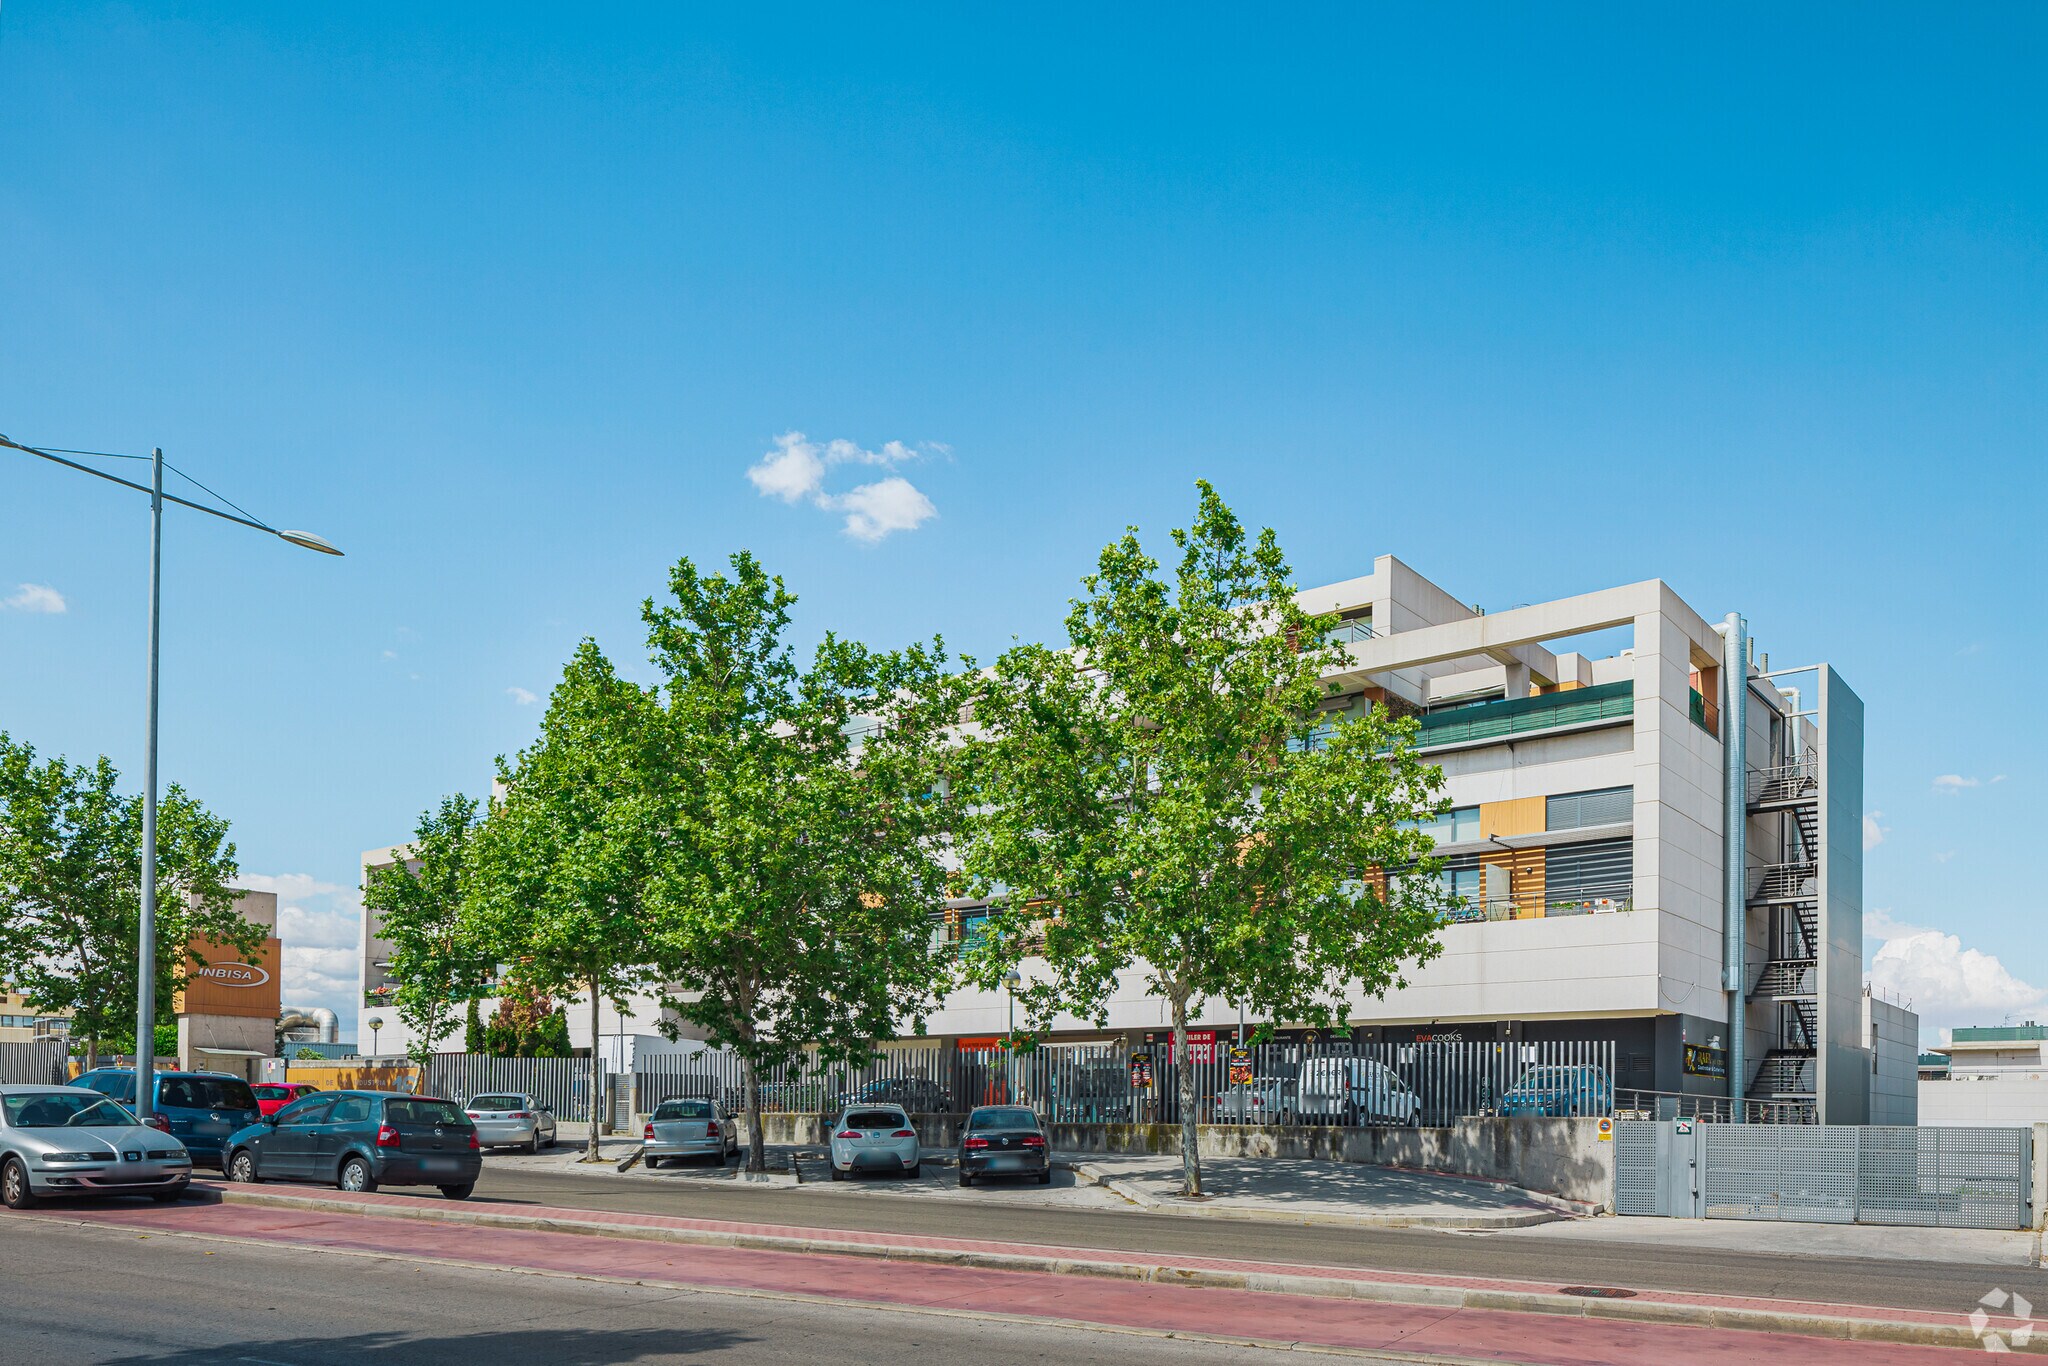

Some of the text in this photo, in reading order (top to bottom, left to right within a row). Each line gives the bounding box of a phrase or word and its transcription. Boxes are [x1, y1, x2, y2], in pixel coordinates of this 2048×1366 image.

[198, 967, 252, 980] INBISA
[1202, 1033, 1211, 1041] DE
[1415, 1033, 1462, 1042] EVACOOKS
[353, 1079, 386, 1087] INDUSTRIA
